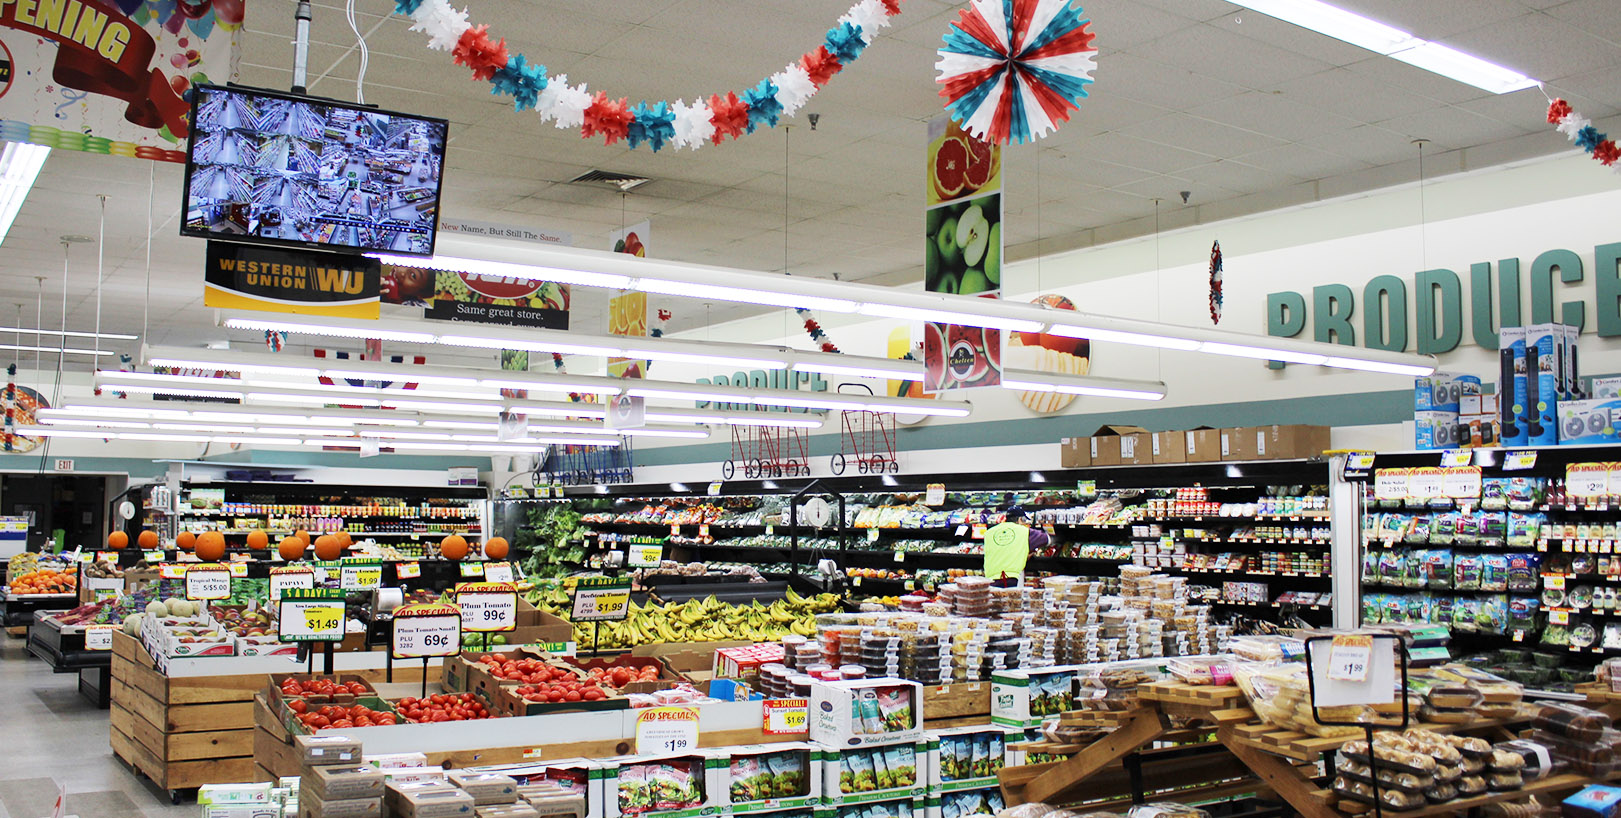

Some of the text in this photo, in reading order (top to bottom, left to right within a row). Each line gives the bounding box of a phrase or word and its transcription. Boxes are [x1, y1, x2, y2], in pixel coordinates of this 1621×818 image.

[441, 222, 562, 243] New Name, But Still The Same.
[219, 258, 364, 294] WESTERN WU
[246, 273, 306, 290] UNION
[456, 304, 544, 320] Same great store.
[1267, 242, 1621, 370] PRODUCE
[59, 460, 73, 470] EXIT
[358, 577, 378, 585] $1.99
[482, 601, 512, 609] Tomato
[597, 602, 623, 613] $1.99
[483, 609, 506, 622] 99¢
[308, 619, 339, 630] $1.49
[424, 634, 449, 648] 69¢
[643, 712, 657, 724] AD
[787, 716, 806, 724] $1.69
[664, 739, 687, 752] $1.99
[864, 735, 881, 744] Baked
